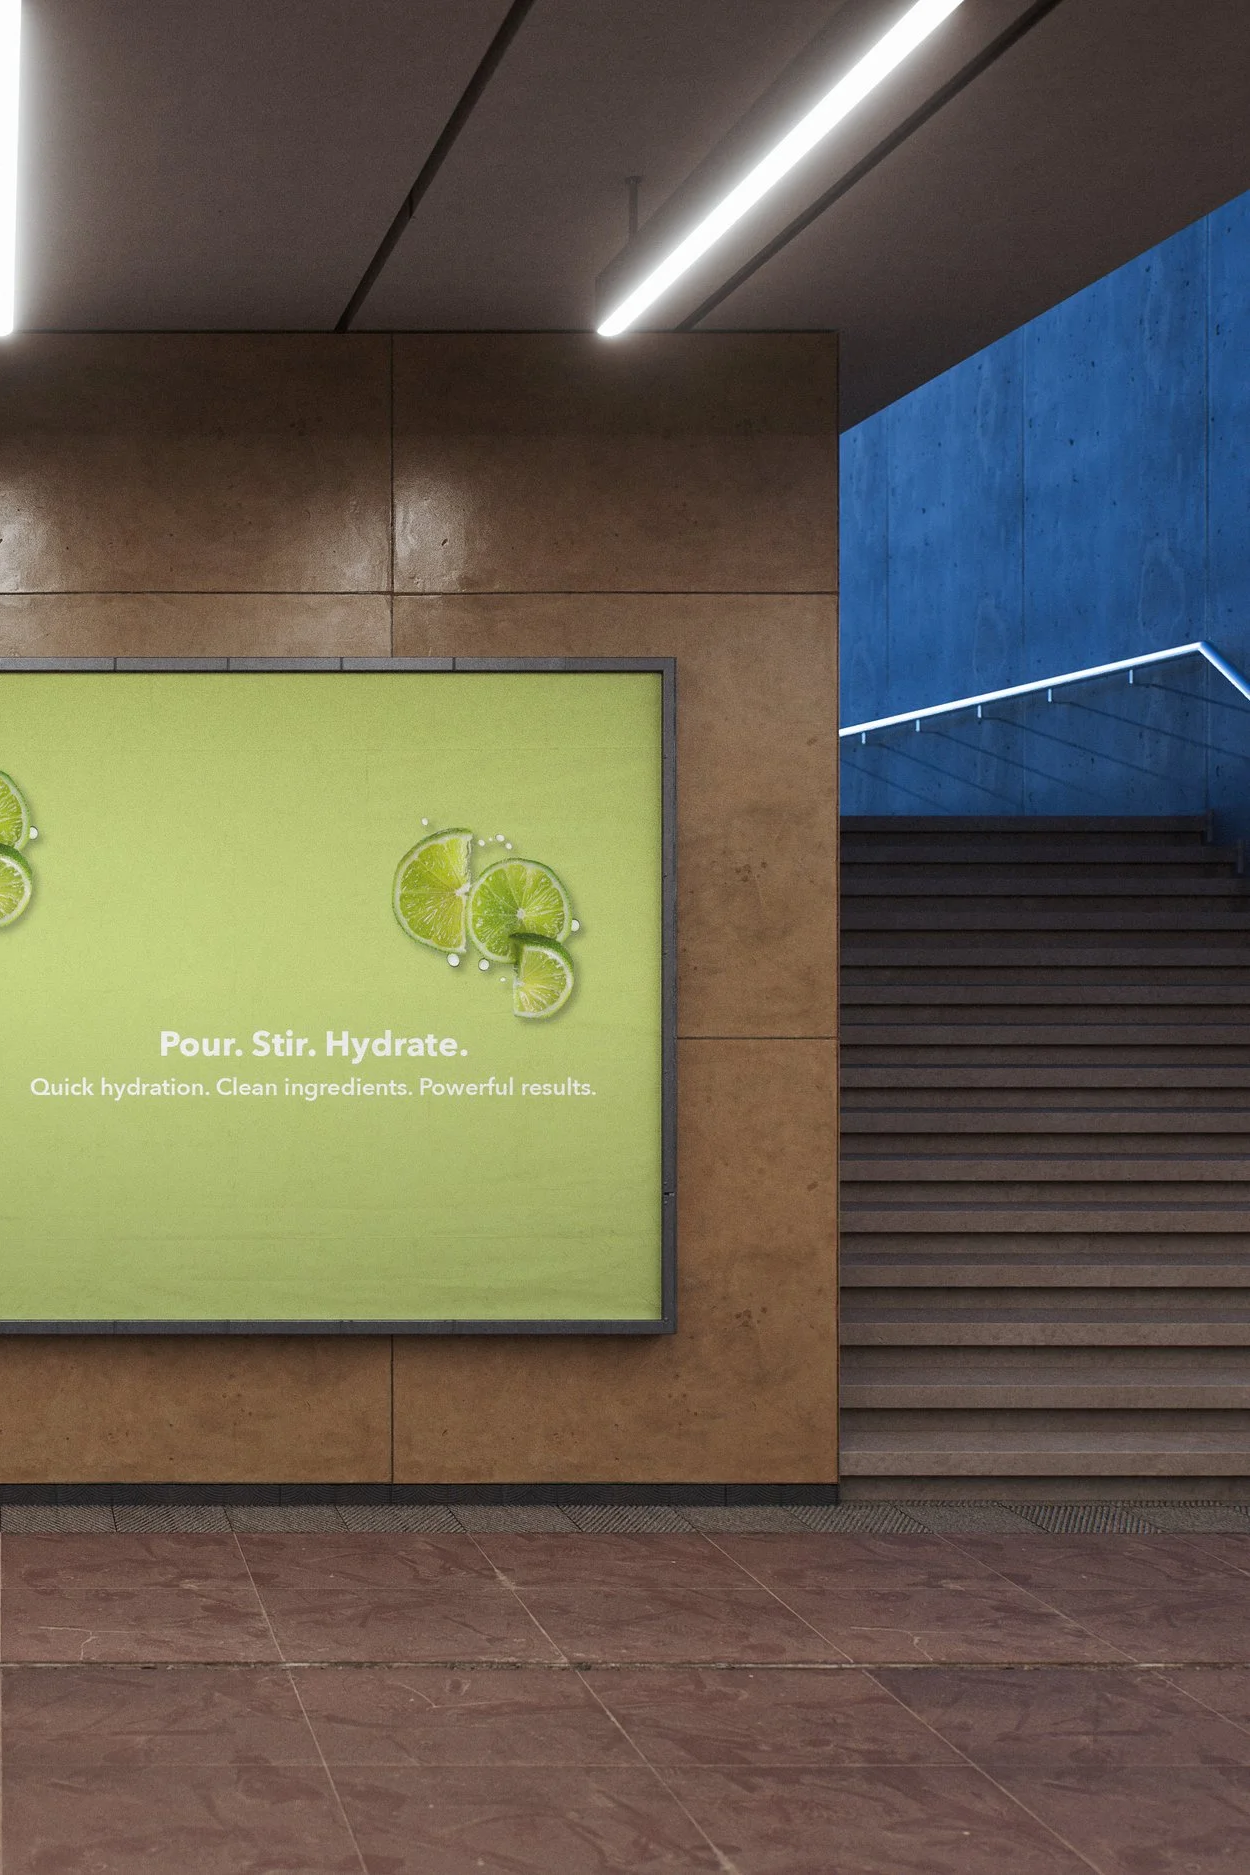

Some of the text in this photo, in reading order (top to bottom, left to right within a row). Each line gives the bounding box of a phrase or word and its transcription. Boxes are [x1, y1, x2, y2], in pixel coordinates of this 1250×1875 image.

[160, 1029, 469, 1064] Pour. Stir. Hydrate.
[30, 1077, 597, 1101] Quick hydration. Clean ingredients. Powerful results.
